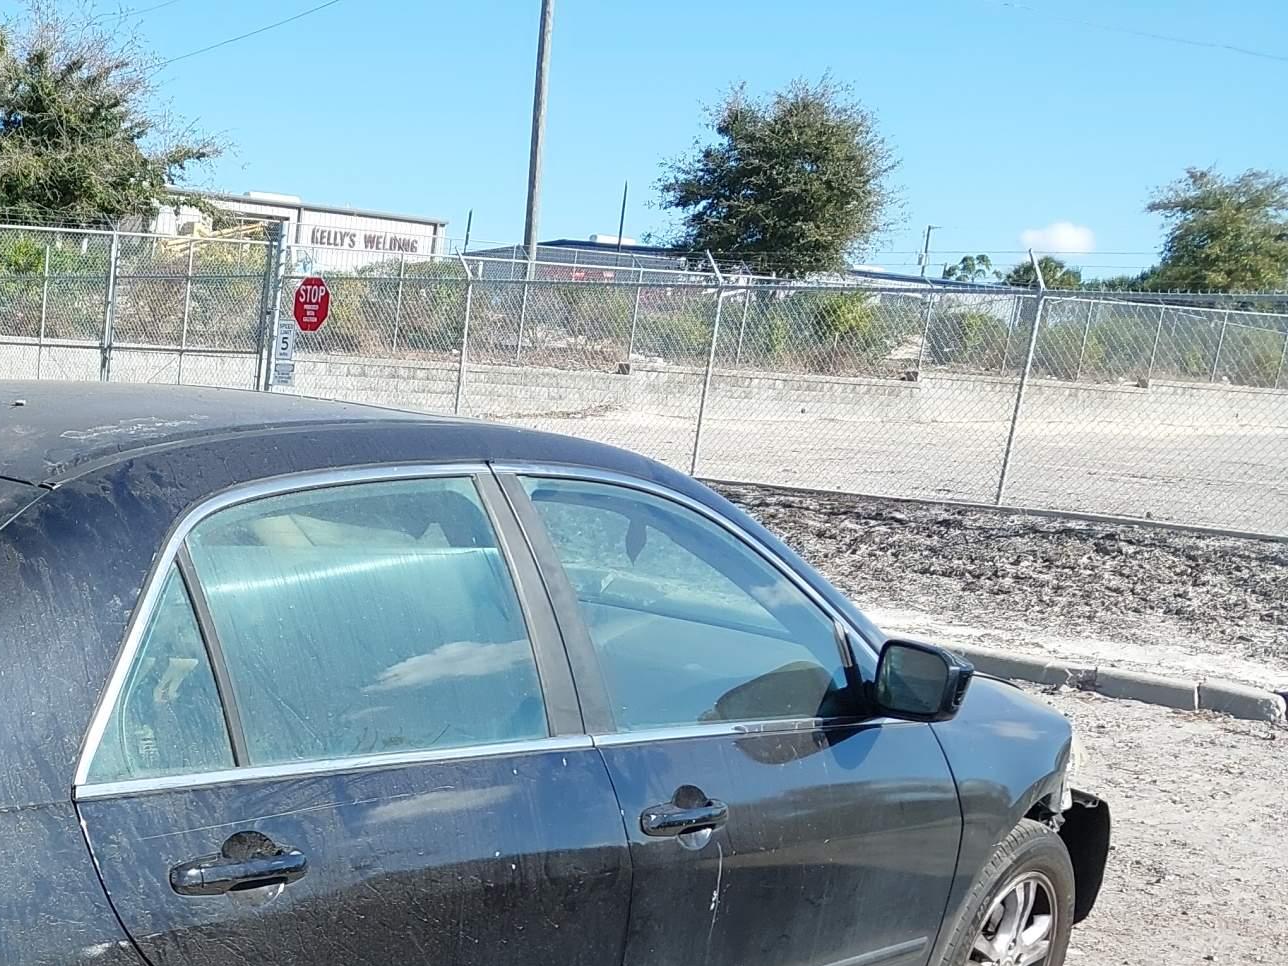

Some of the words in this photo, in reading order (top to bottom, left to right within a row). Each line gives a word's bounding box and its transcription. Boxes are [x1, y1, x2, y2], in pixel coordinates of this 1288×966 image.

[311, 226, 357, 249] KELLY'S
[363, 233, 418, 253] WELDING
[299, 285, 326, 303] STOP
[281, 336, 289, 351] 5
